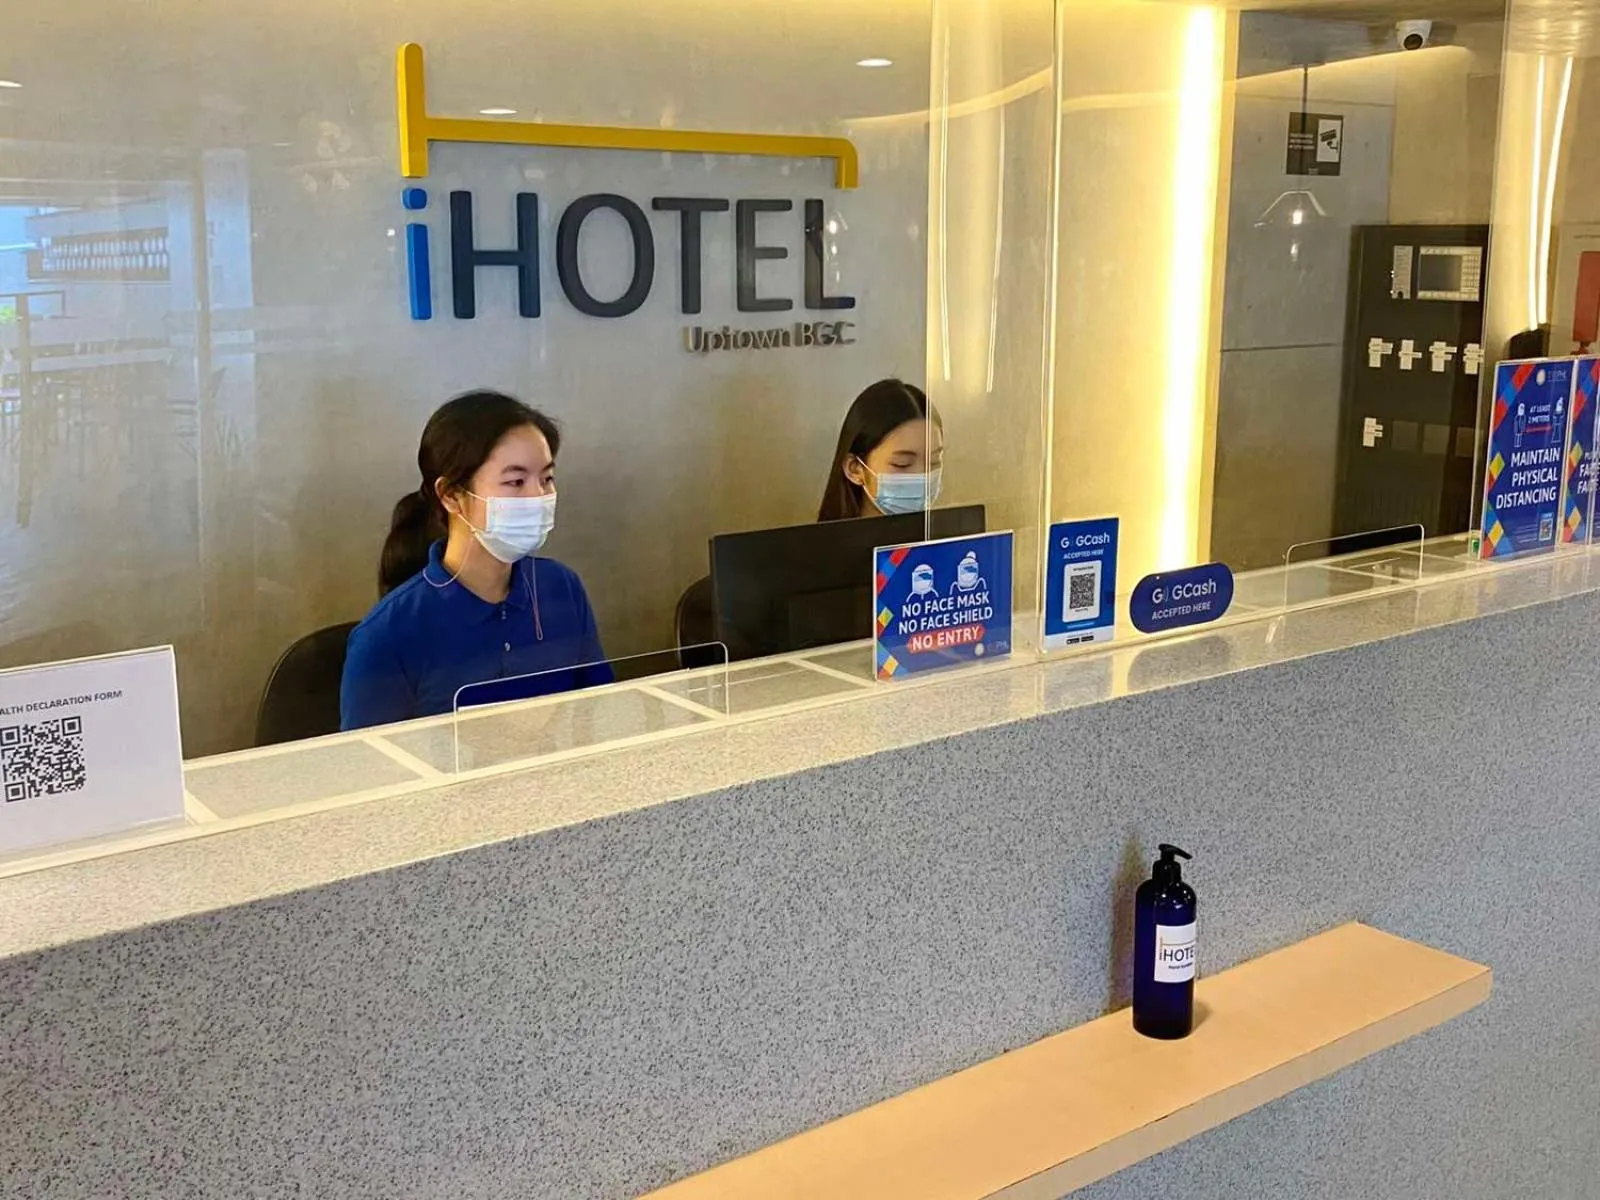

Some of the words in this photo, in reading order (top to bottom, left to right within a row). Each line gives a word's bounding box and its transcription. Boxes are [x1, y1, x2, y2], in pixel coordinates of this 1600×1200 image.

[402, 187, 856, 320] iHOTEL
[683, 326, 791, 355] Uptown
[794, 321, 857, 347] BGC
[1511, 447, 1560, 468] MAINTAIN
[1511, 467, 1558, 487] PHYSICAL
[1495, 486, 1556, 509] DISTANCING
[1076, 532, 1110, 546] GCash
[1063, 550, 1090, 560] ACCEPTED
[1091, 548, 1104, 556] HERE
[1172, 579, 1217, 600] GCash
[902, 603, 921, 618] NO
[924, 597, 954, 614] FACE
[957, 591, 990, 608] MASK
[1152, 605, 1191, 621] ACCEPTED
[1192, 601, 1211, 613] HERE
[898, 619, 917, 635] NO
[921, 611, 950, 630] FACE
[953, 607, 993, 625] SHIELD
[912, 635, 932, 650] NO
[937, 626, 980, 646] ENTRY
[26, 695, 92, 712] DECLARATION
[94, 690, 122, 701] FORM
